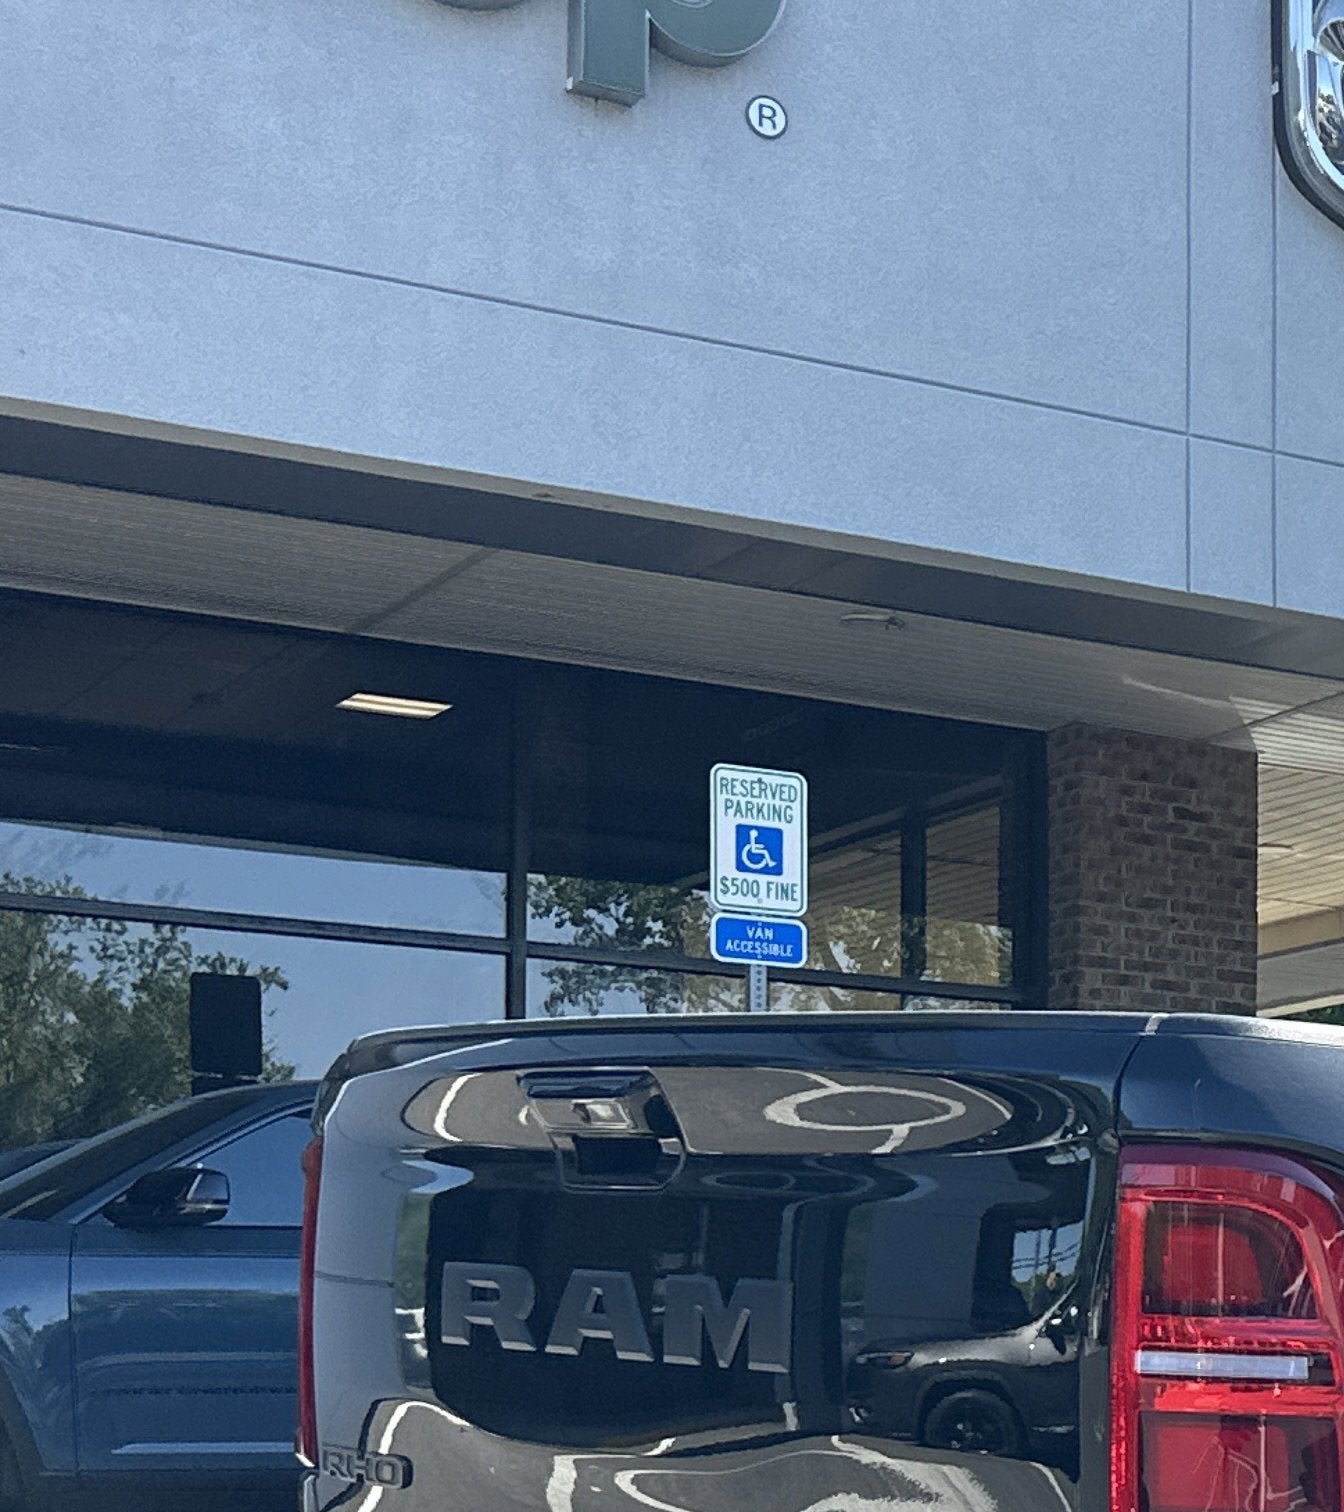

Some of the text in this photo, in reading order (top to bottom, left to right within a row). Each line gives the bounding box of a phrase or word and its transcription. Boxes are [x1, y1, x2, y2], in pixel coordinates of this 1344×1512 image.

[719, 777, 798, 803] RESERVED
[724, 798, 794, 824] PARKING
[719, 876, 799, 902] $500 FINE
[746, 925, 774, 940] VAN
[725, 939, 793, 957] ACCESSIBLE
[441, 1261, 793, 1374] RAM
